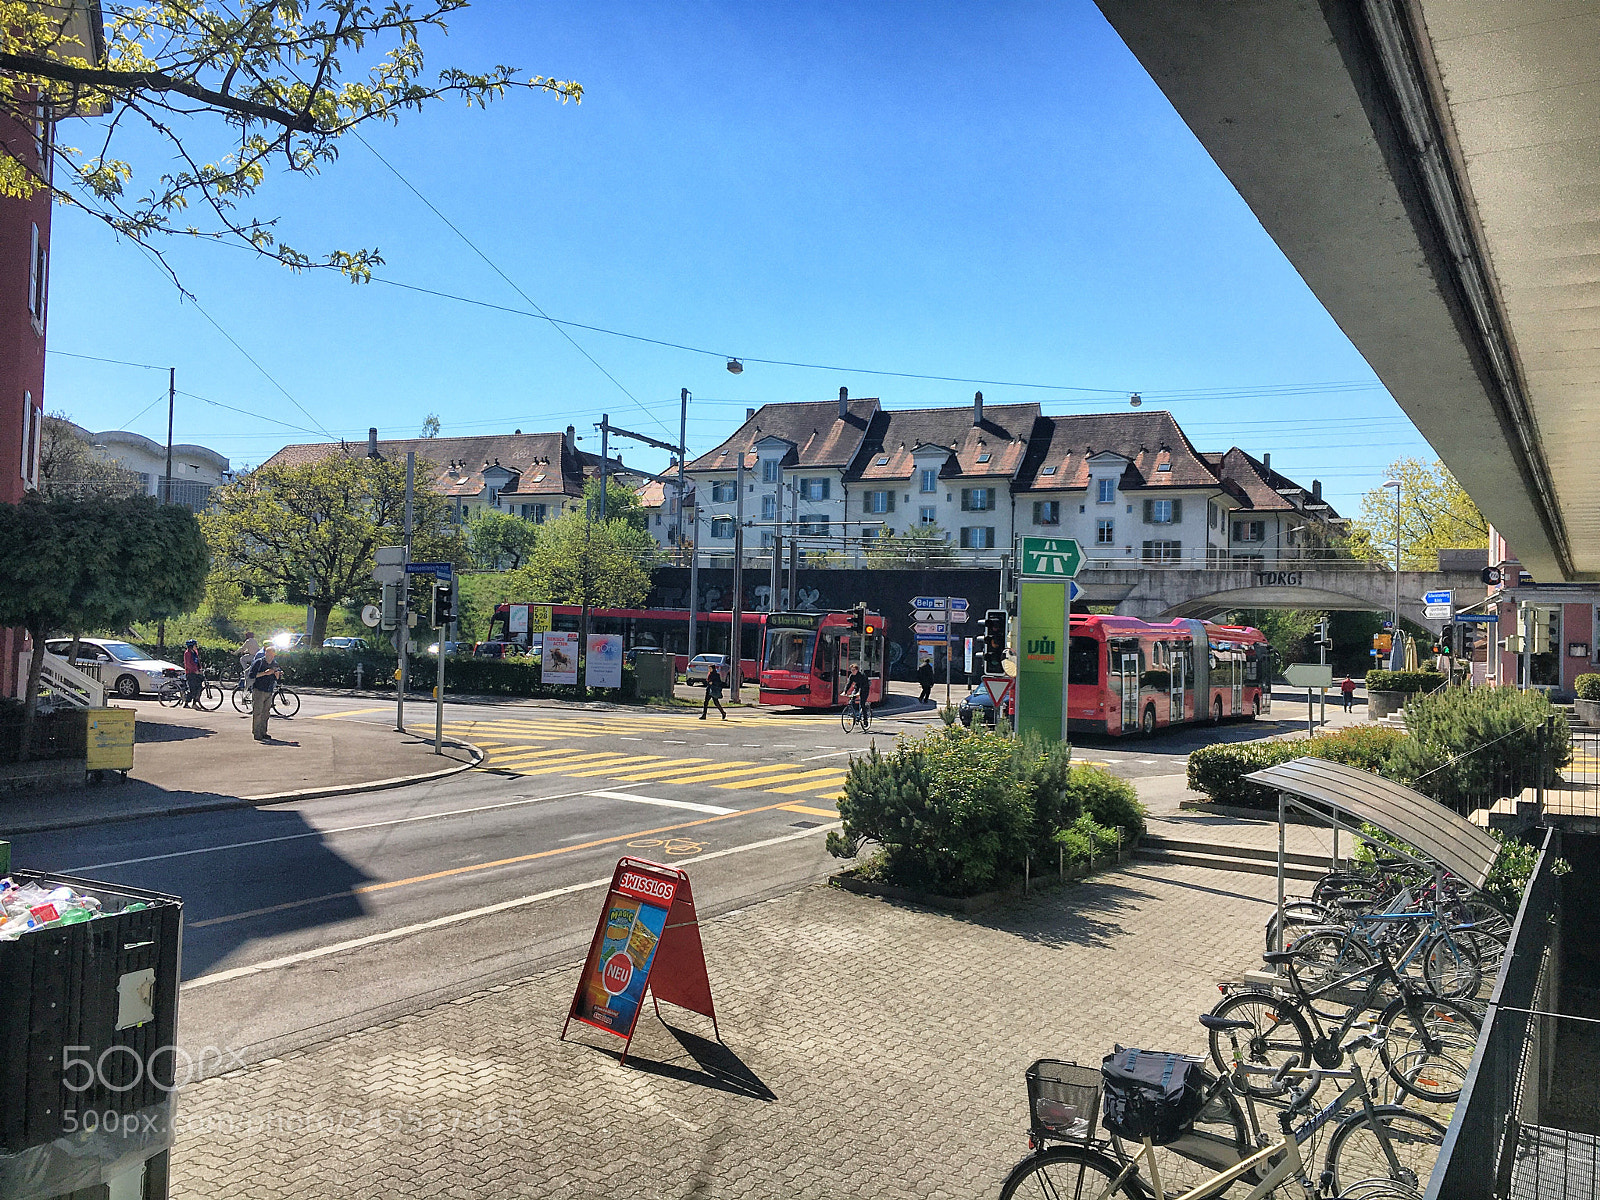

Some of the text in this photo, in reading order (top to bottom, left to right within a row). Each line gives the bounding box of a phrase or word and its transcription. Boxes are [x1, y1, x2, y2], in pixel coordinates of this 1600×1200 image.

[916, 599, 934, 608] Belp
[619, 872, 674, 900] SWISSLOS
[610, 910, 633, 923] MAGIC
[606, 963, 629, 983] NEU
